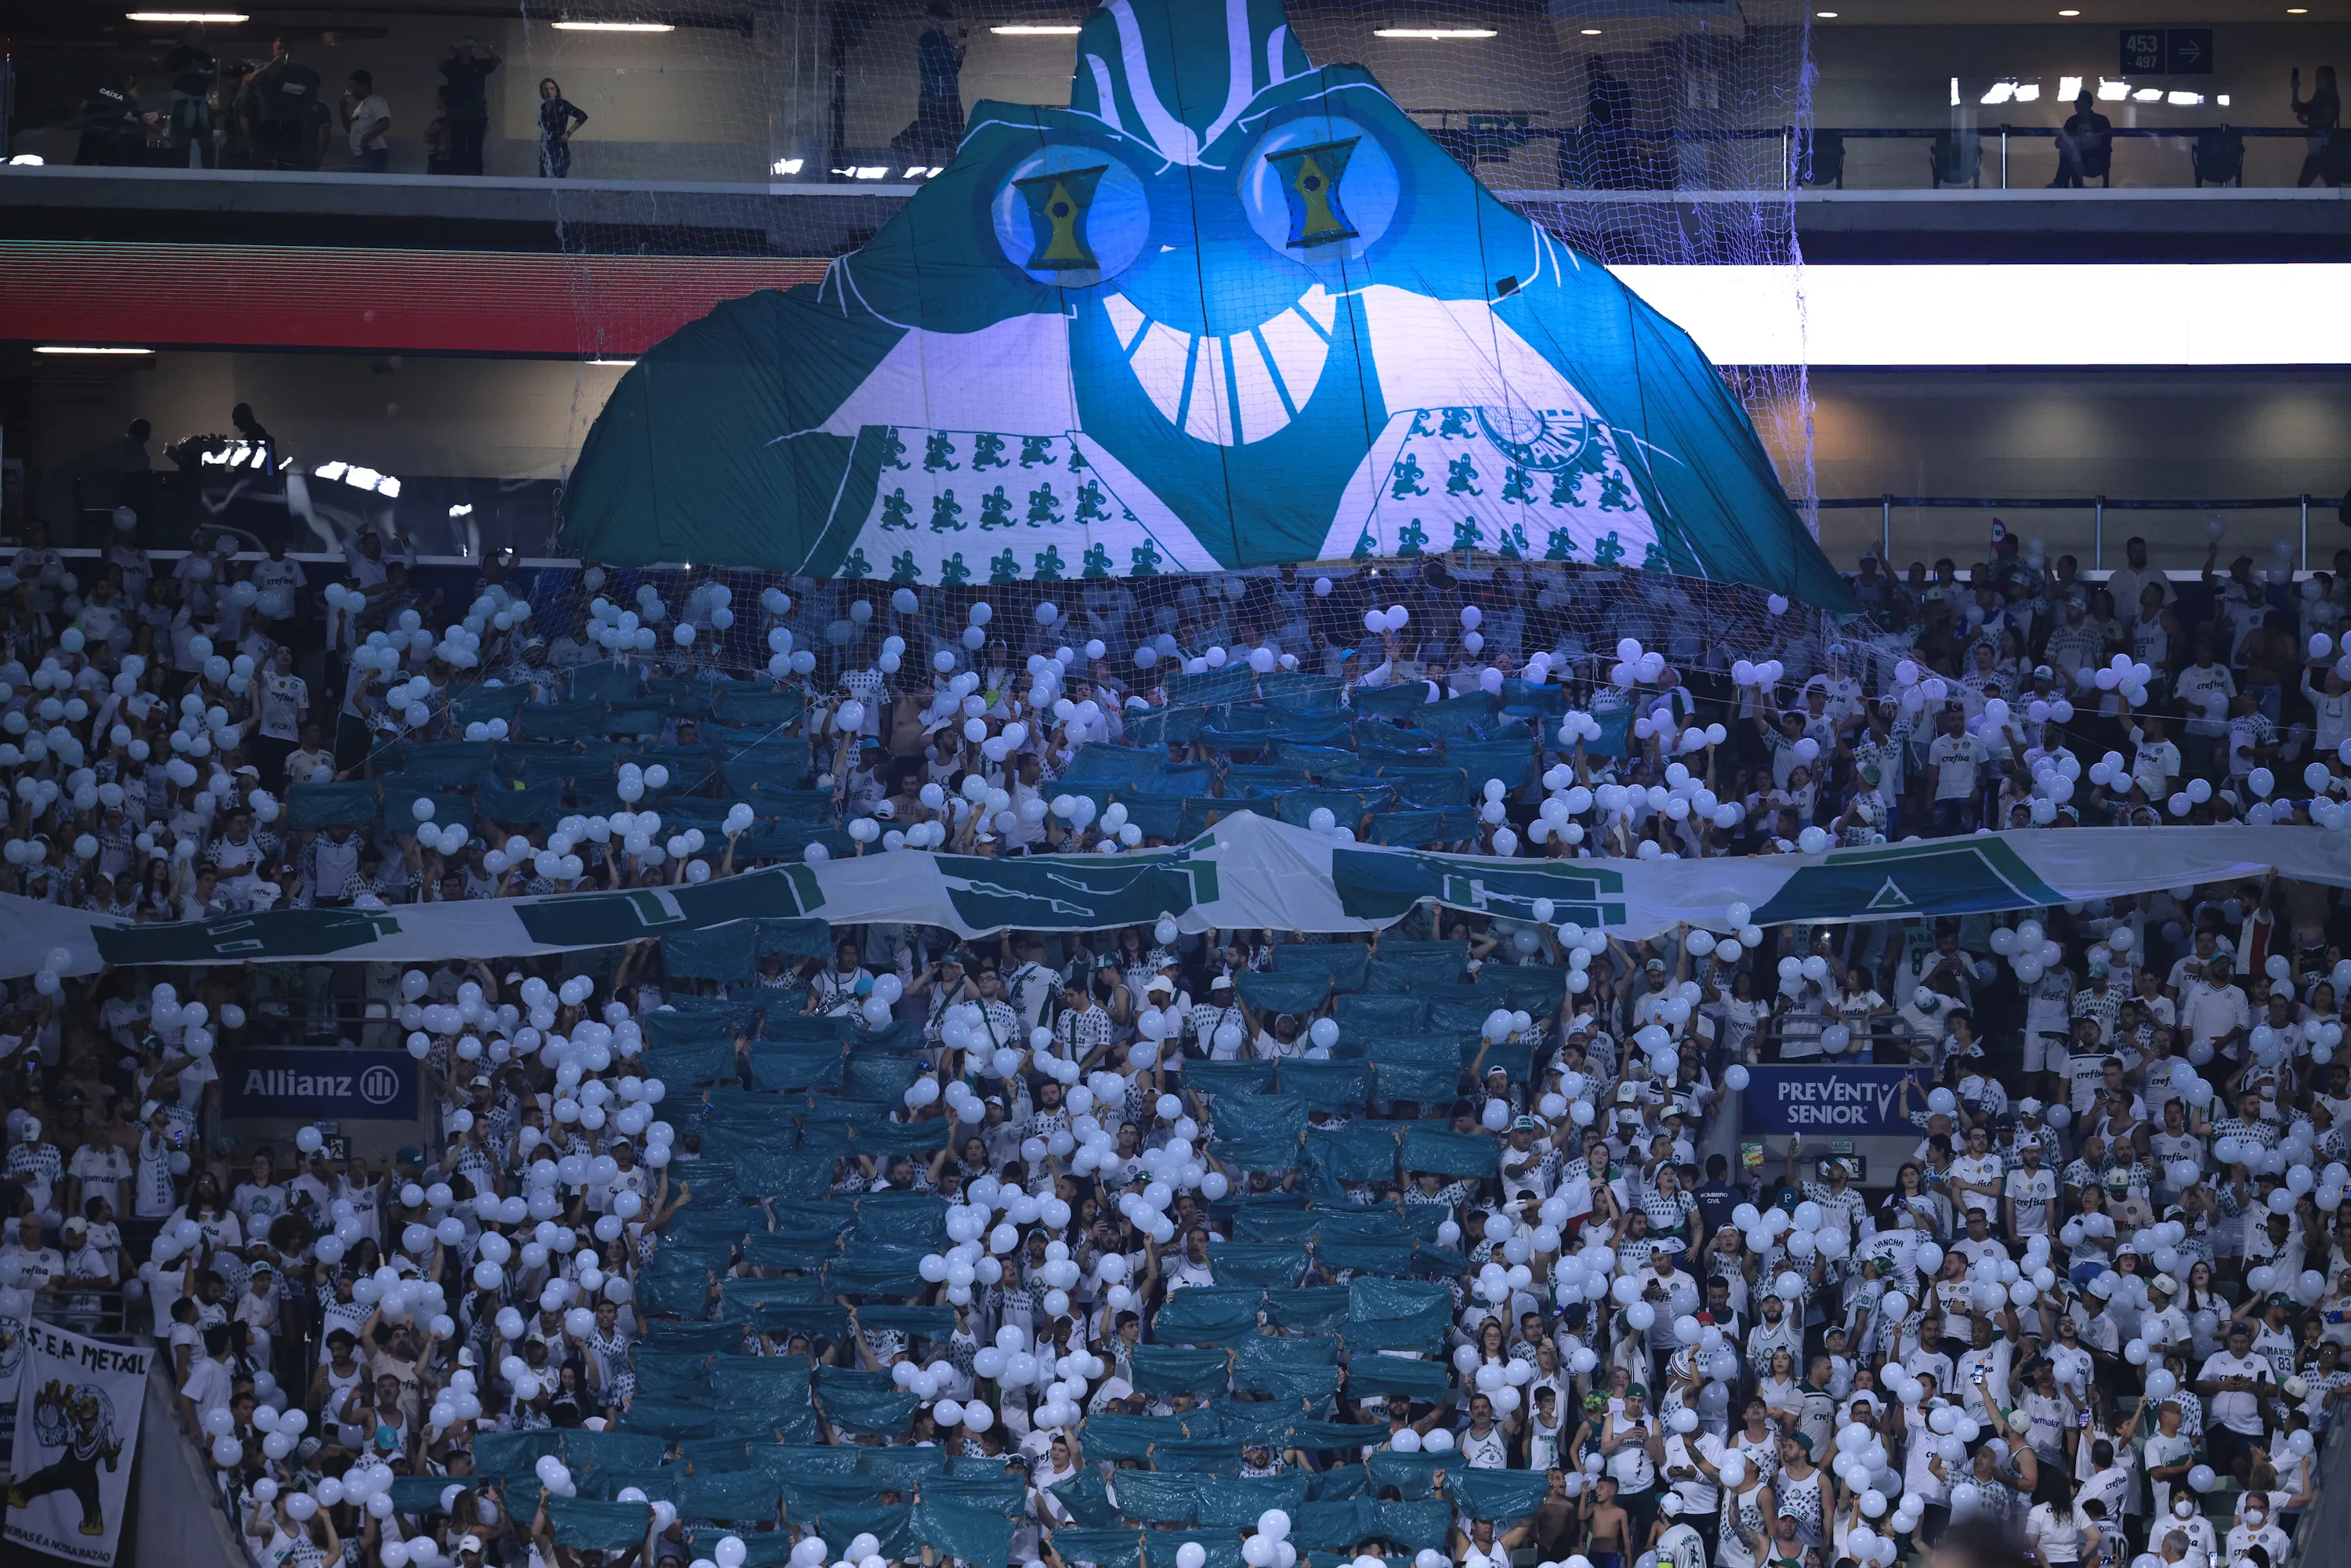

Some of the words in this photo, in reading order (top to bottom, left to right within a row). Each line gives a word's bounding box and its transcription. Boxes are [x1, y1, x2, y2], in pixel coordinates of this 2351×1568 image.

[2127, 35, 2158, 53] 453
[2135, 56, 2157, 68] 497
[99, 88, 124, 101] CAIXA
[266, 576, 294, 586] crefisa
[2197, 680, 2225, 690] crefisa
[1826, 694, 1846, 703] efisa
[1942, 754, 1969, 764] crefisa
[2138, 751, 2157, 763] crefisa
[1732, 1022, 1755, 1031] crefisa
[243, 1069, 352, 1096] Allianz
[2153, 1077, 2172, 1086] cref
[1778, 1075, 1877, 1101] PREVENT
[1788, 1105, 1867, 1124] SENIOR
[2257, 1117, 2281, 1127] refisa
[2158, 1153, 2188, 1164] crefisa
[1784, 1193, 1791, 1203] P
[2016, 1197, 2046, 1209] crefisa
[353, 1203, 374, 1213] efisa
[22, 1266, 49, 1276] refisa
[81, 1345, 147, 1375] METAL
[2278, 1357, 2292, 1371] 83
[1034, 1450, 1050, 1463] cref
[2106, 1476, 2126, 1490] crefisa
[1681, 1535, 1701, 1549] MANCHA
[1724, 1529, 1737, 1543] VERD
[2108, 1537, 2127, 1564] 10
